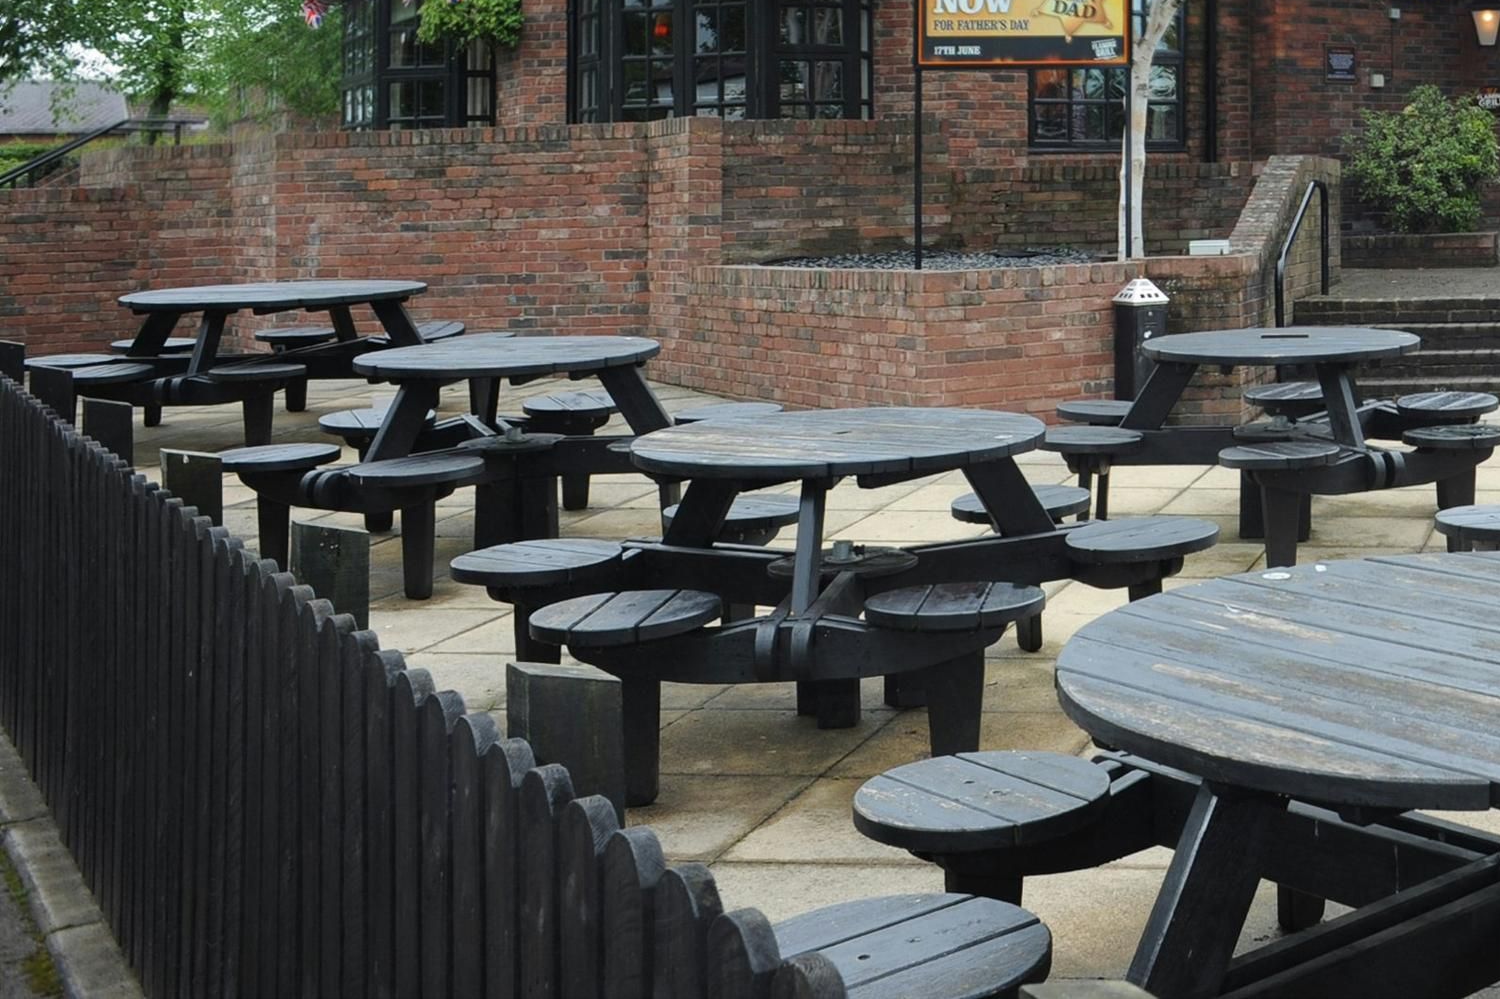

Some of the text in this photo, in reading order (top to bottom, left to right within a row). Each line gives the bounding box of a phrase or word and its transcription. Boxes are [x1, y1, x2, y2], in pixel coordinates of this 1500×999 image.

[1053, 0, 1096, 18] DAD
[933, 20, 1029, 31] FOR FATHER'S DAY
[934, 46, 981, 56] 17TH JUNE
